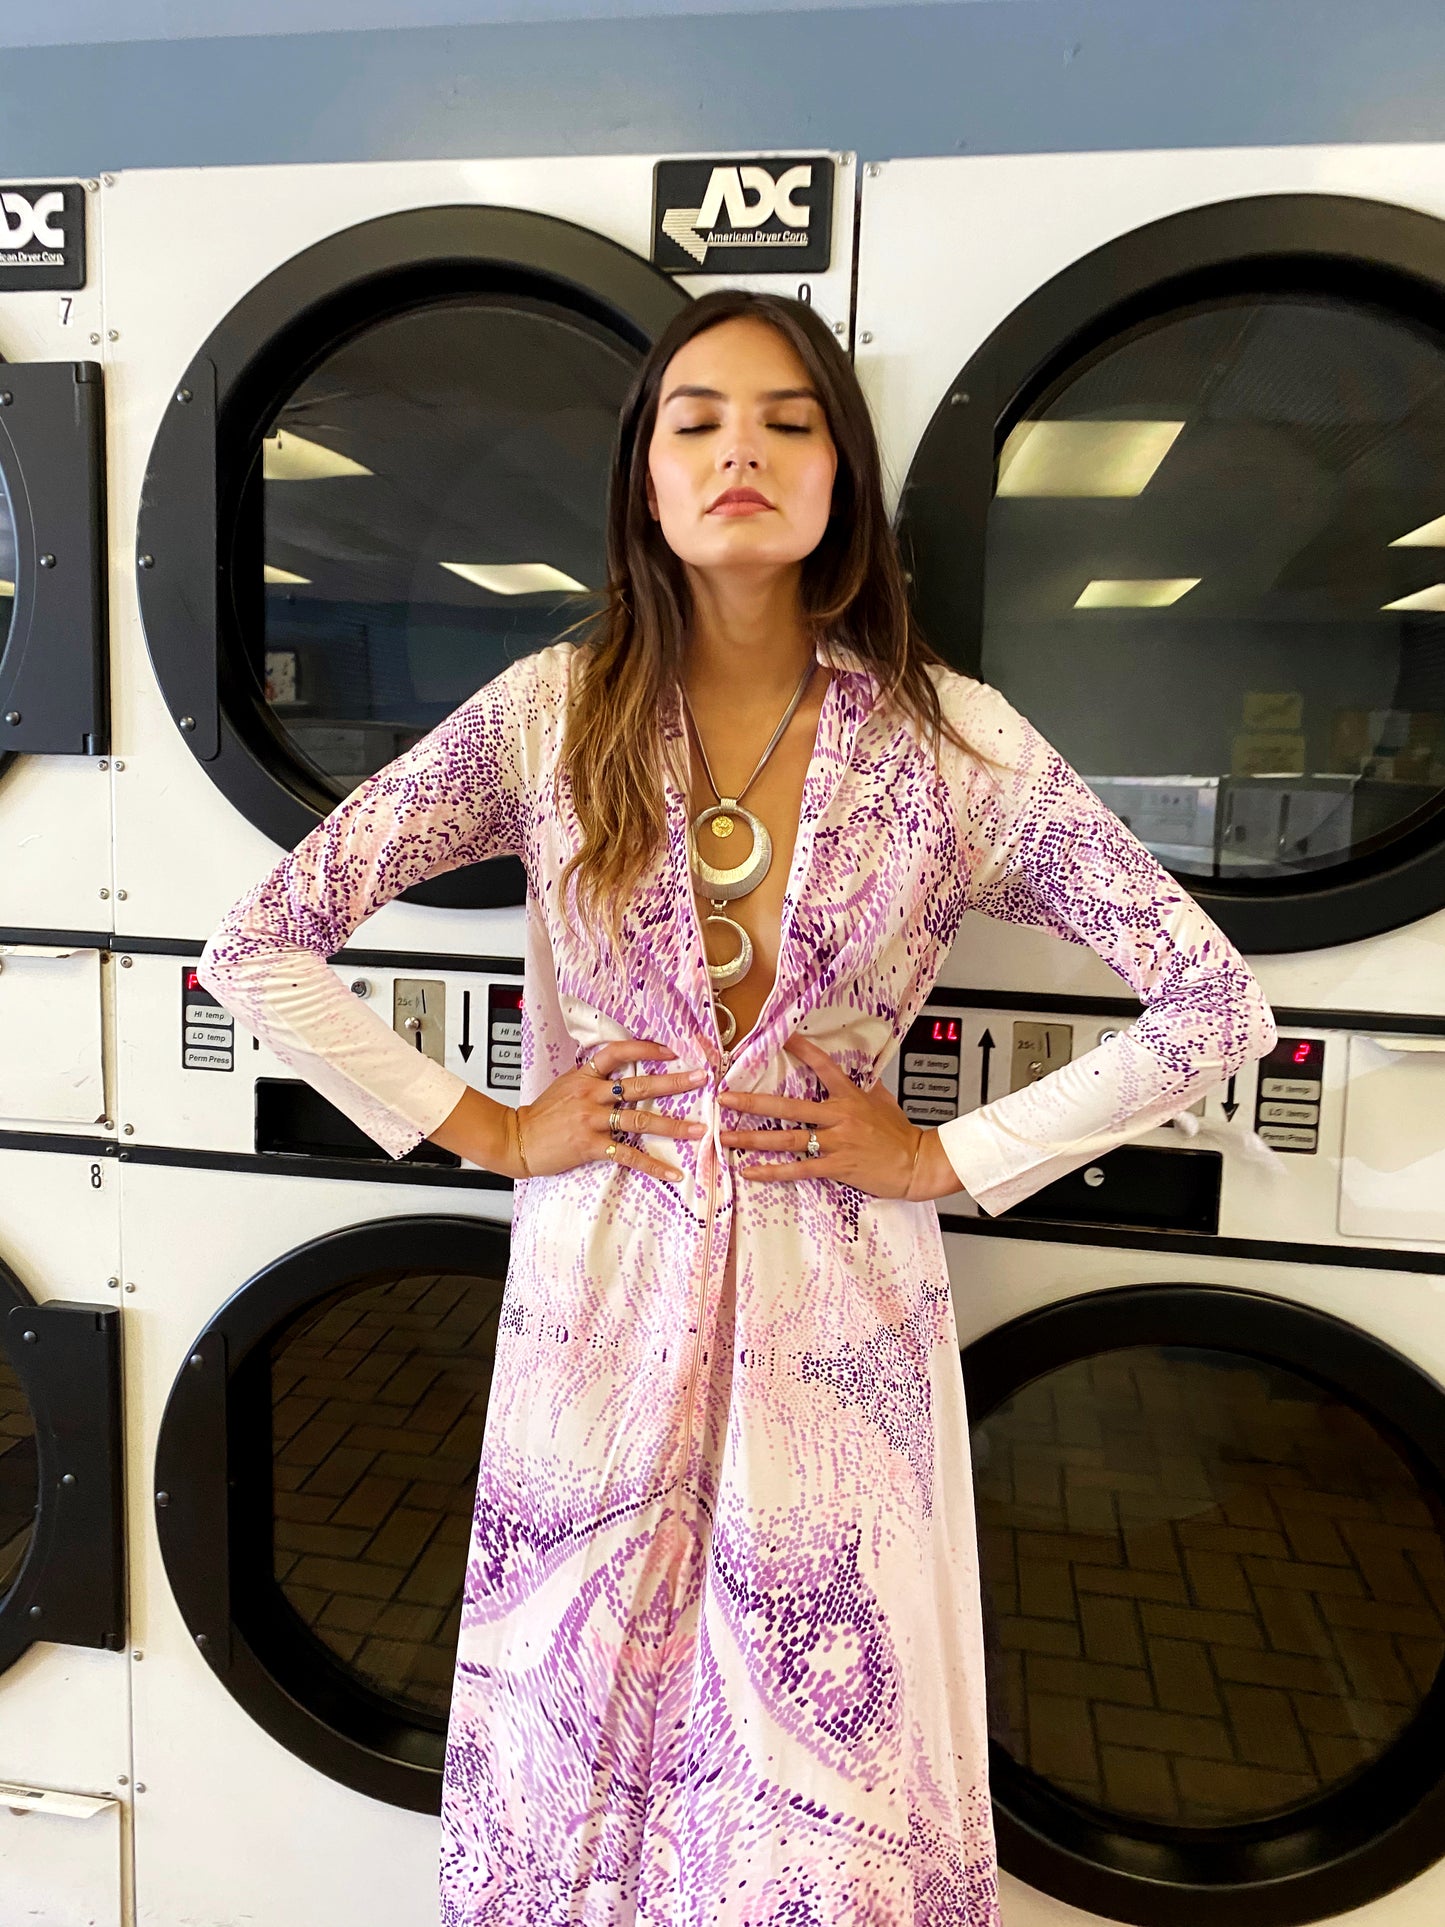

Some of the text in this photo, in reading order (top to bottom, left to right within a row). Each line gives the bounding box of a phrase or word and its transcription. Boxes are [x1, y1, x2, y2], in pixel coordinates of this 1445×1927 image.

[696, 165, 812, 229] ADC
[0, 192, 65, 249] DC
[707, 231, 754, 243] American
[755, 230, 782, 244] Dryer
[60, 297, 72, 325] 7
[194, 1010, 224, 1020] HI temp
[192, 1032, 225, 1043] LO temp
[500, 1028, 509, 1036] HI
[498, 1050, 510, 1058] LO
[1293, 1043, 1310, 1063] 2
[188, 1054, 230, 1065] Perm Press
[494, 1072, 514, 1081] Perm
[91, 1163, 102, 1189] 8
